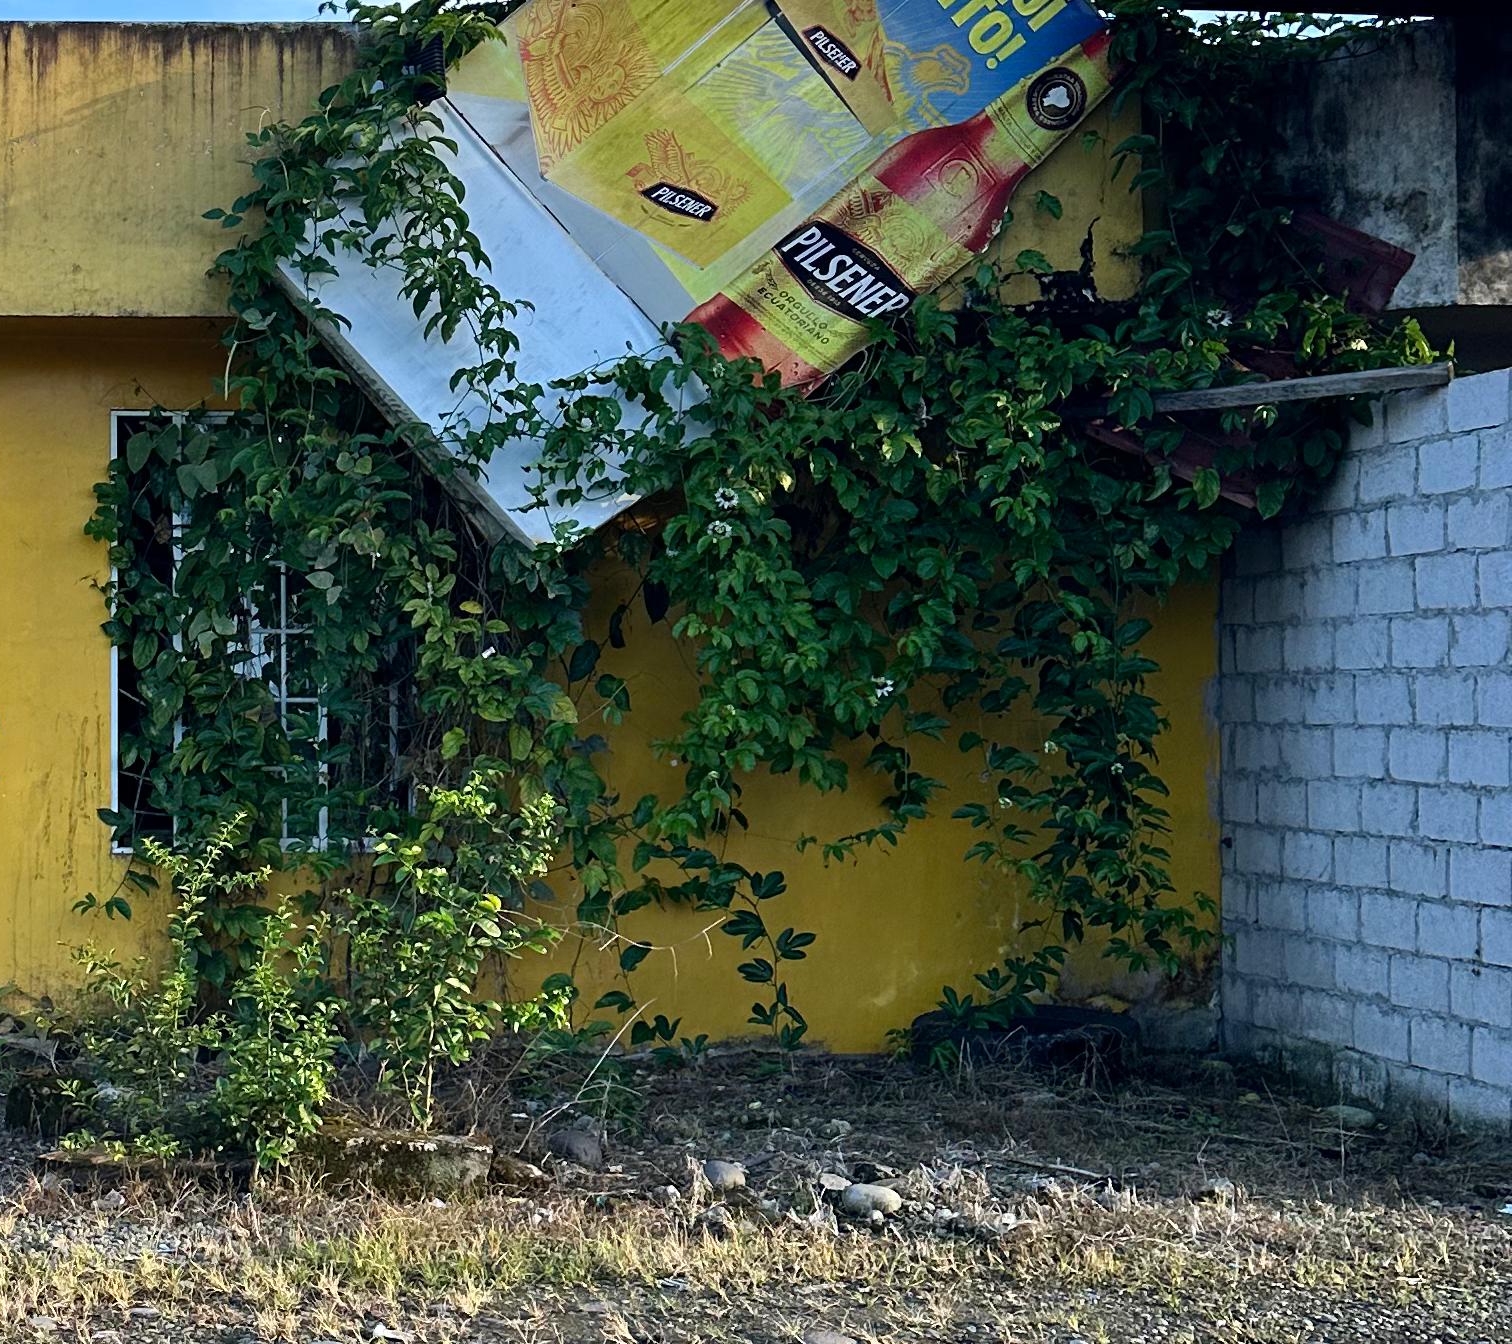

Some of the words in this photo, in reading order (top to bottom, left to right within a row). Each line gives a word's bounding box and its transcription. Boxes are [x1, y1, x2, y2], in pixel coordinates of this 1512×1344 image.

[650, 186, 712, 218] PILSENER
[757, 286, 830, 346] ECUATORIANO
[779, 290, 829, 331] ORGULLO
